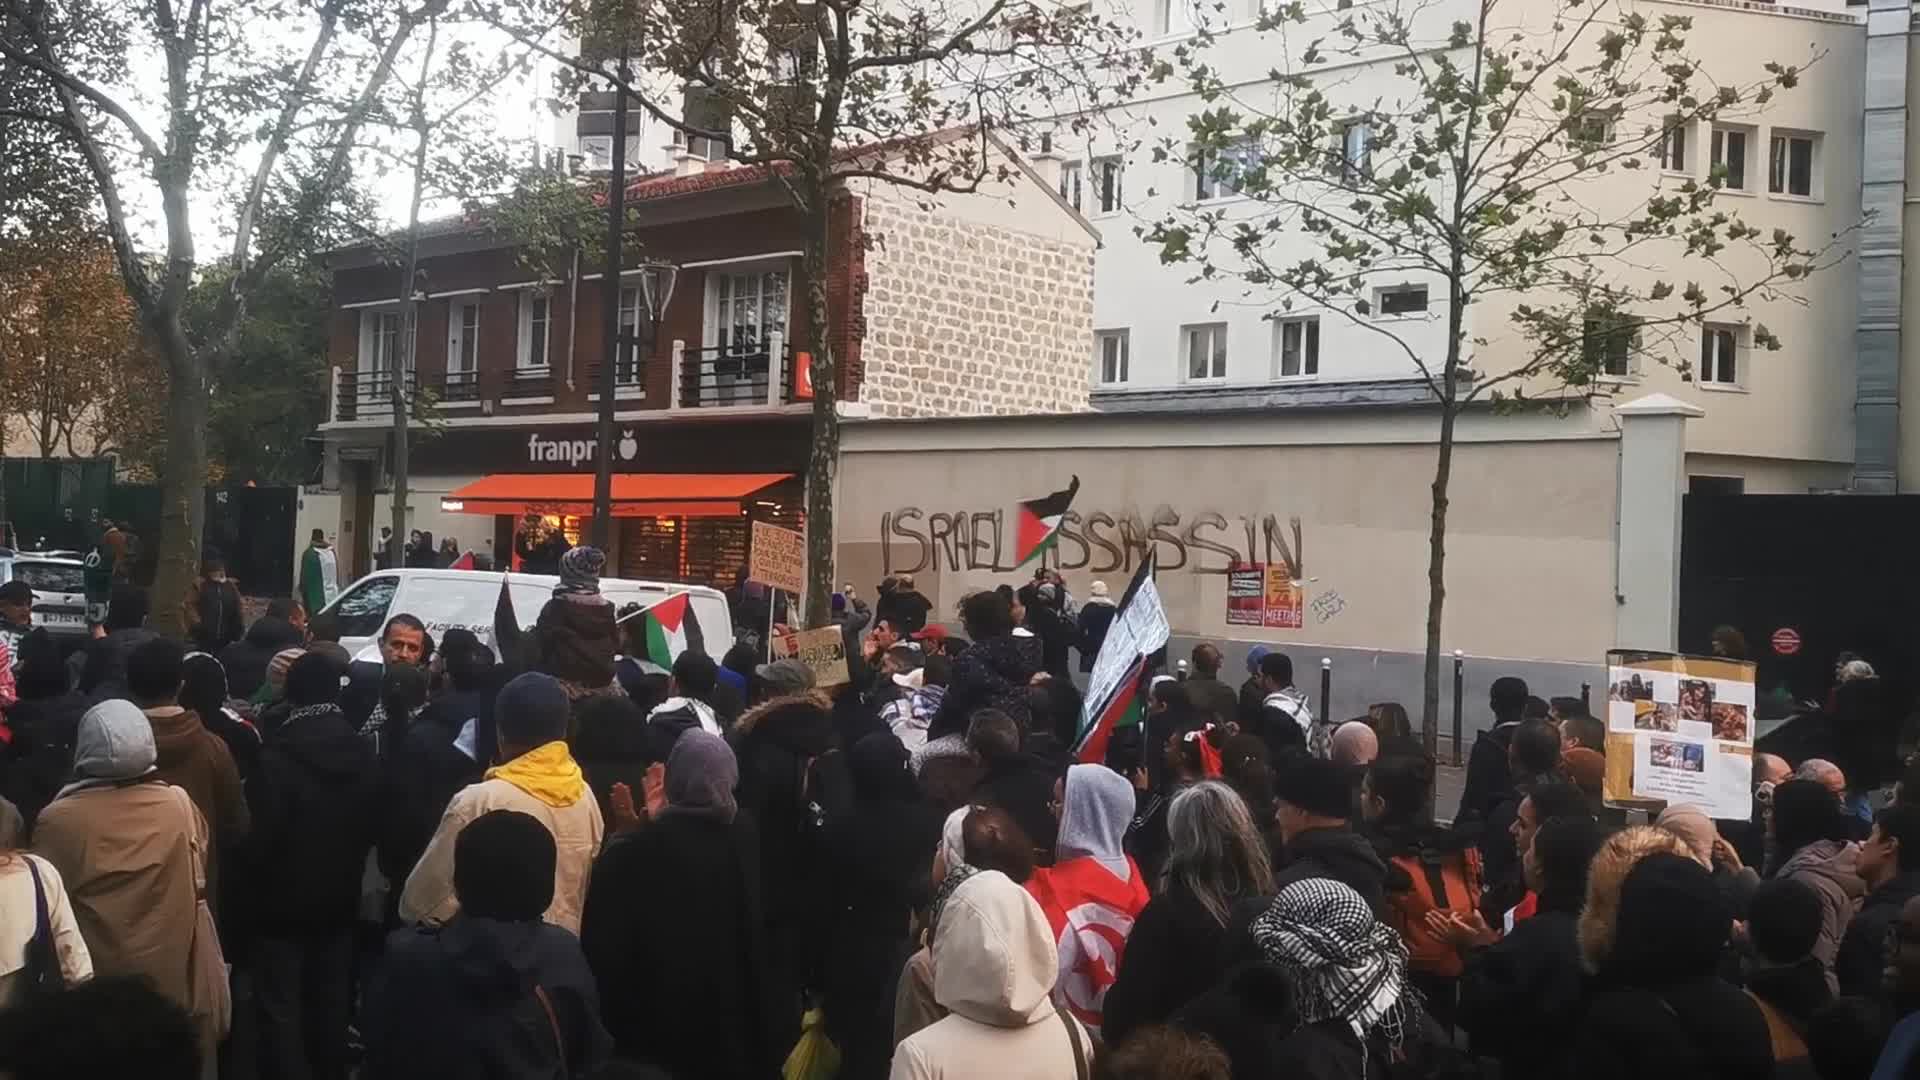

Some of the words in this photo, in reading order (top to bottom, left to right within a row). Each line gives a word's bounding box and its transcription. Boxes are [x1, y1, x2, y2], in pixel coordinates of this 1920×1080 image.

[528, 433, 617, 467] franpr
[881, 507, 1018, 576] ISRAEL
[1266, 609, 1301, 621] MEETING
